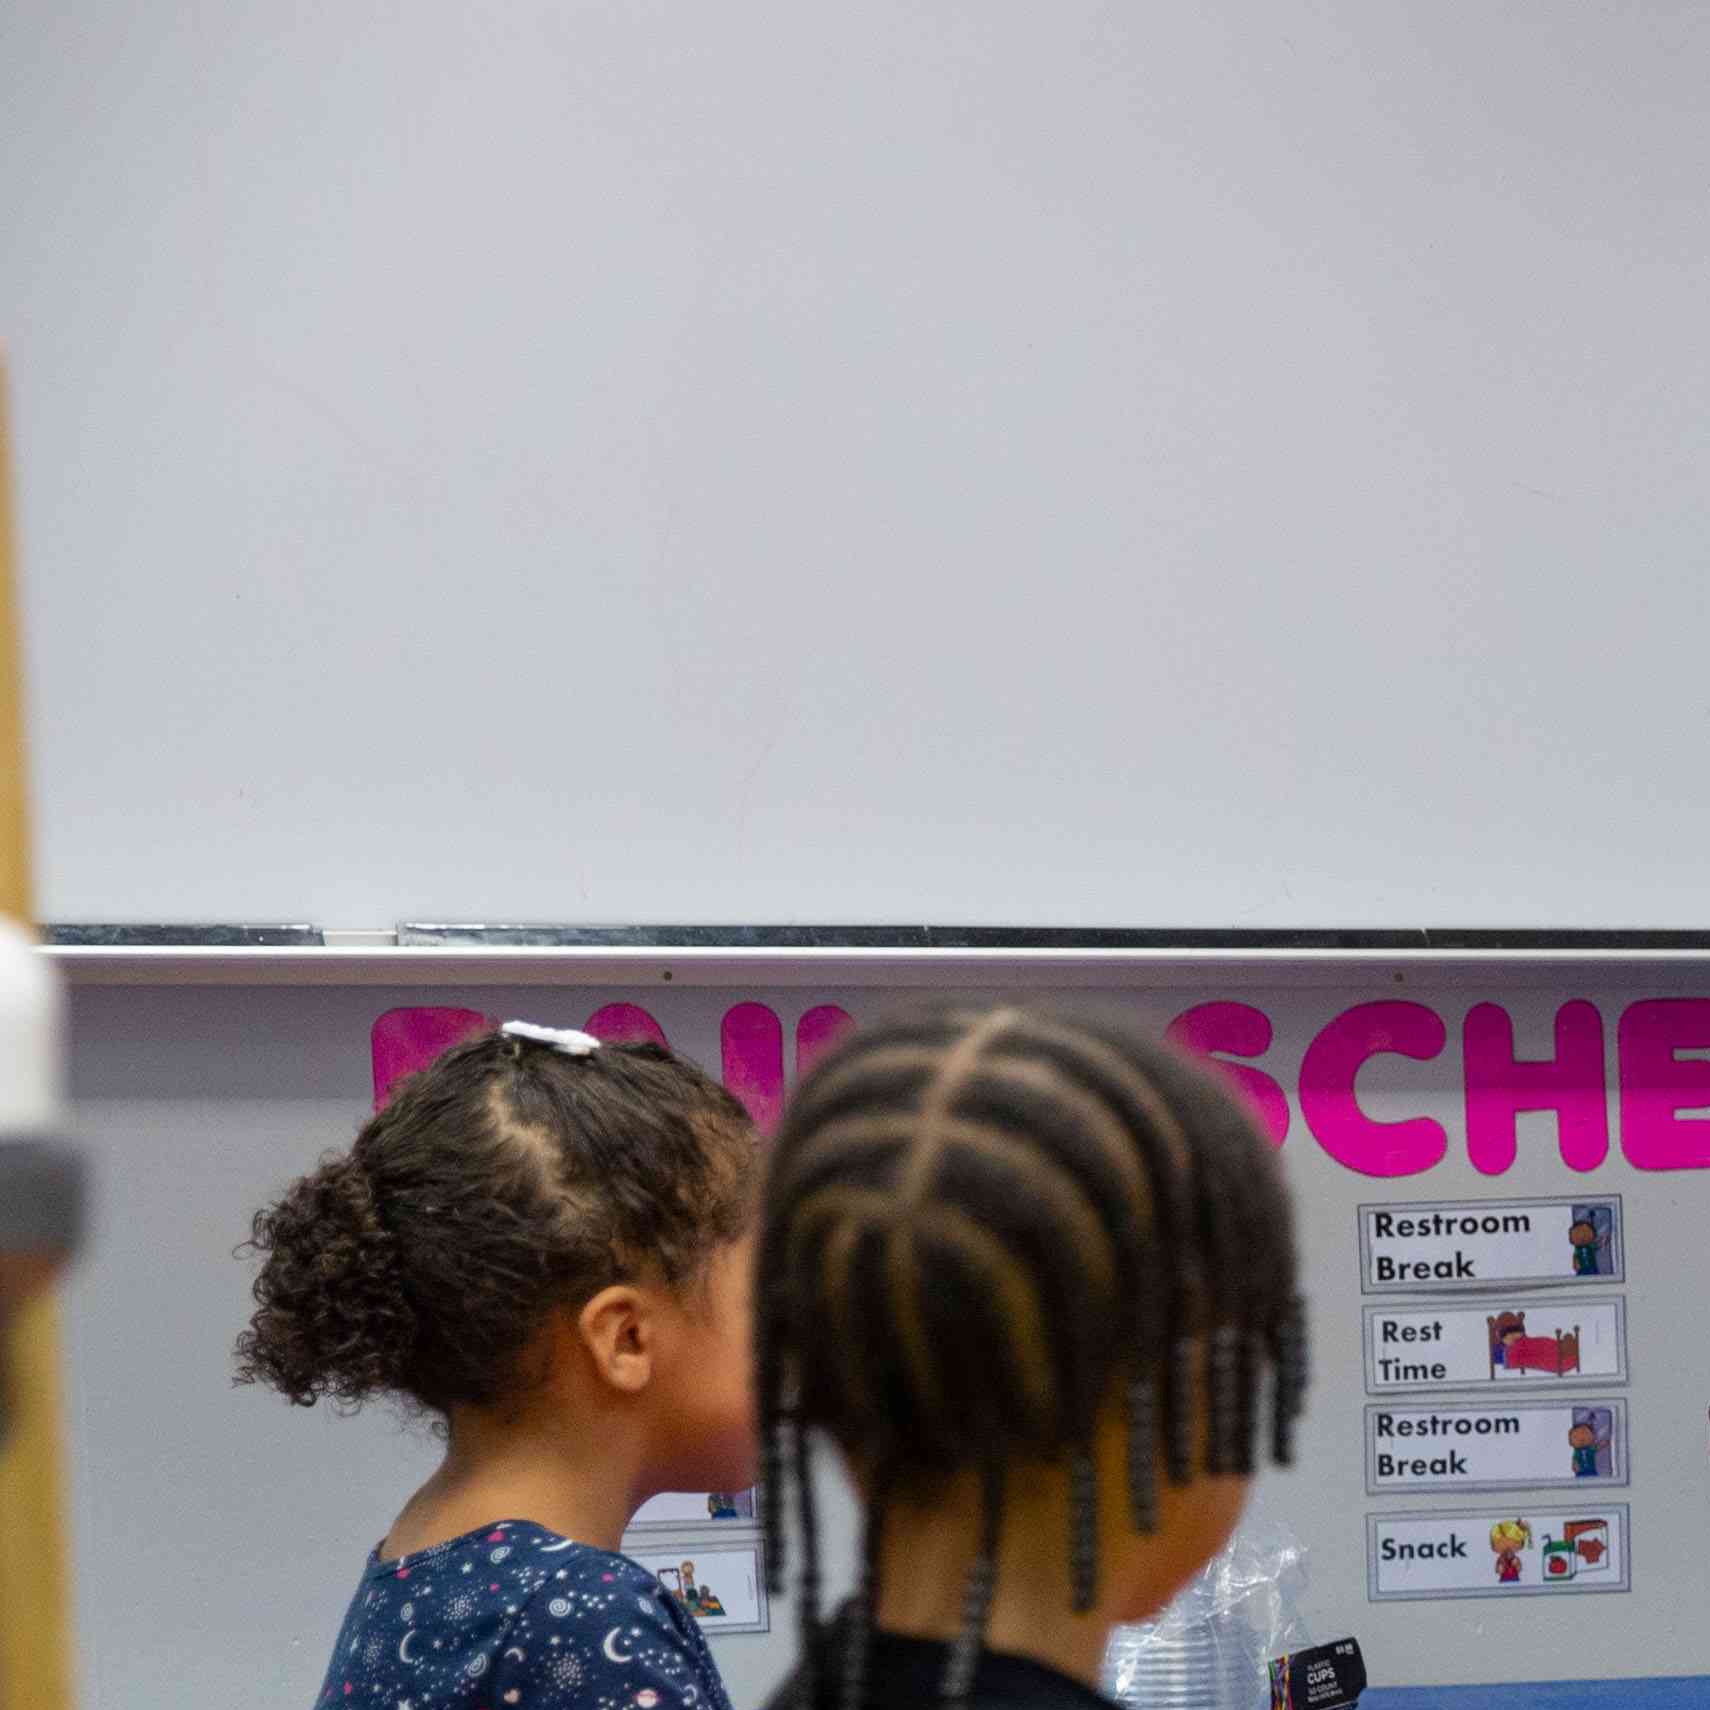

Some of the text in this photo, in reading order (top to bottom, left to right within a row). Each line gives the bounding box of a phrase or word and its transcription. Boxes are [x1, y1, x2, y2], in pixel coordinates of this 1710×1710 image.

[1375, 1211, 1531, 1238] Restroom
[1377, 1251, 1475, 1281] Break
[1382, 1320, 1443, 1343] Rest
[1379, 1357, 1447, 1381] Time
[1377, 1413, 1520, 1438] Restroom
[1378, 1449, 1468, 1478] Break
[1381, 1533, 1468, 1561] Snack
[1306, 1667, 1335, 1685] CUPS
